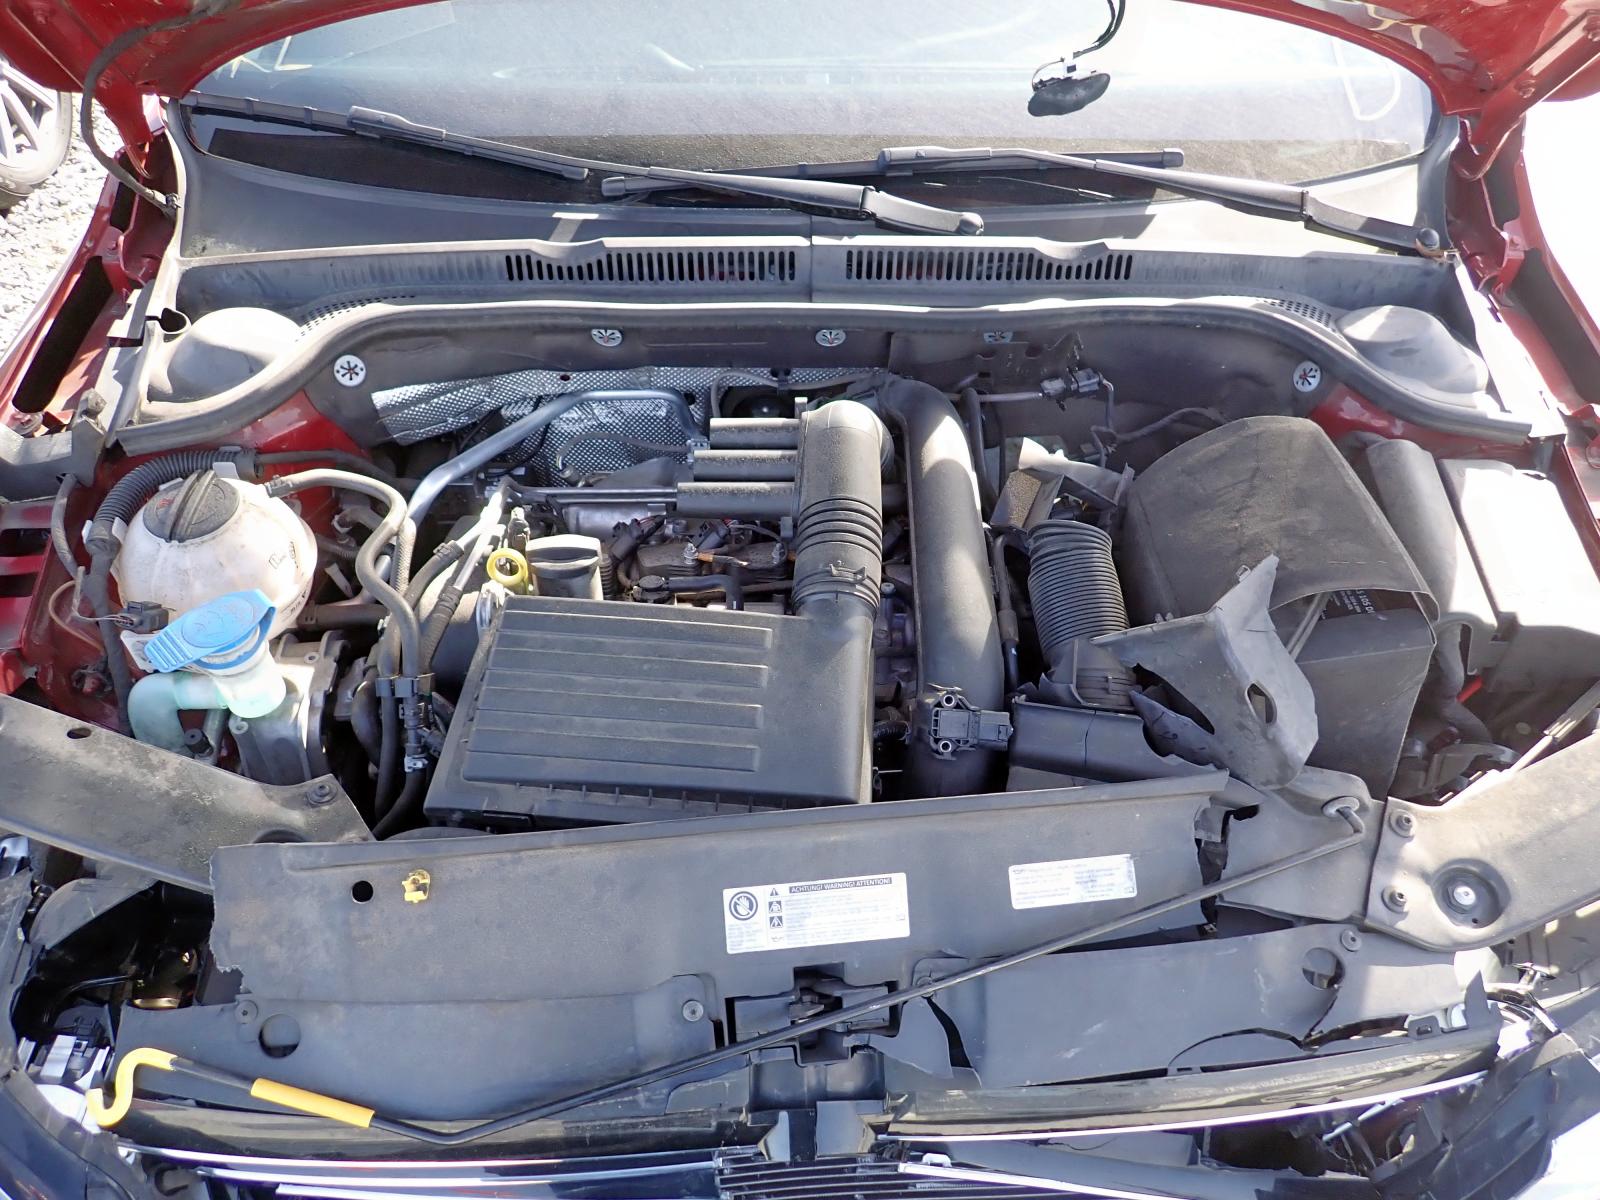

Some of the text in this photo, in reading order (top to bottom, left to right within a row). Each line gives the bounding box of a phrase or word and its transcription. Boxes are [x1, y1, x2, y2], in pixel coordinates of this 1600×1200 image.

[791, 878, 891, 893] ACHTUNG! WARNING! ATTENTION!
